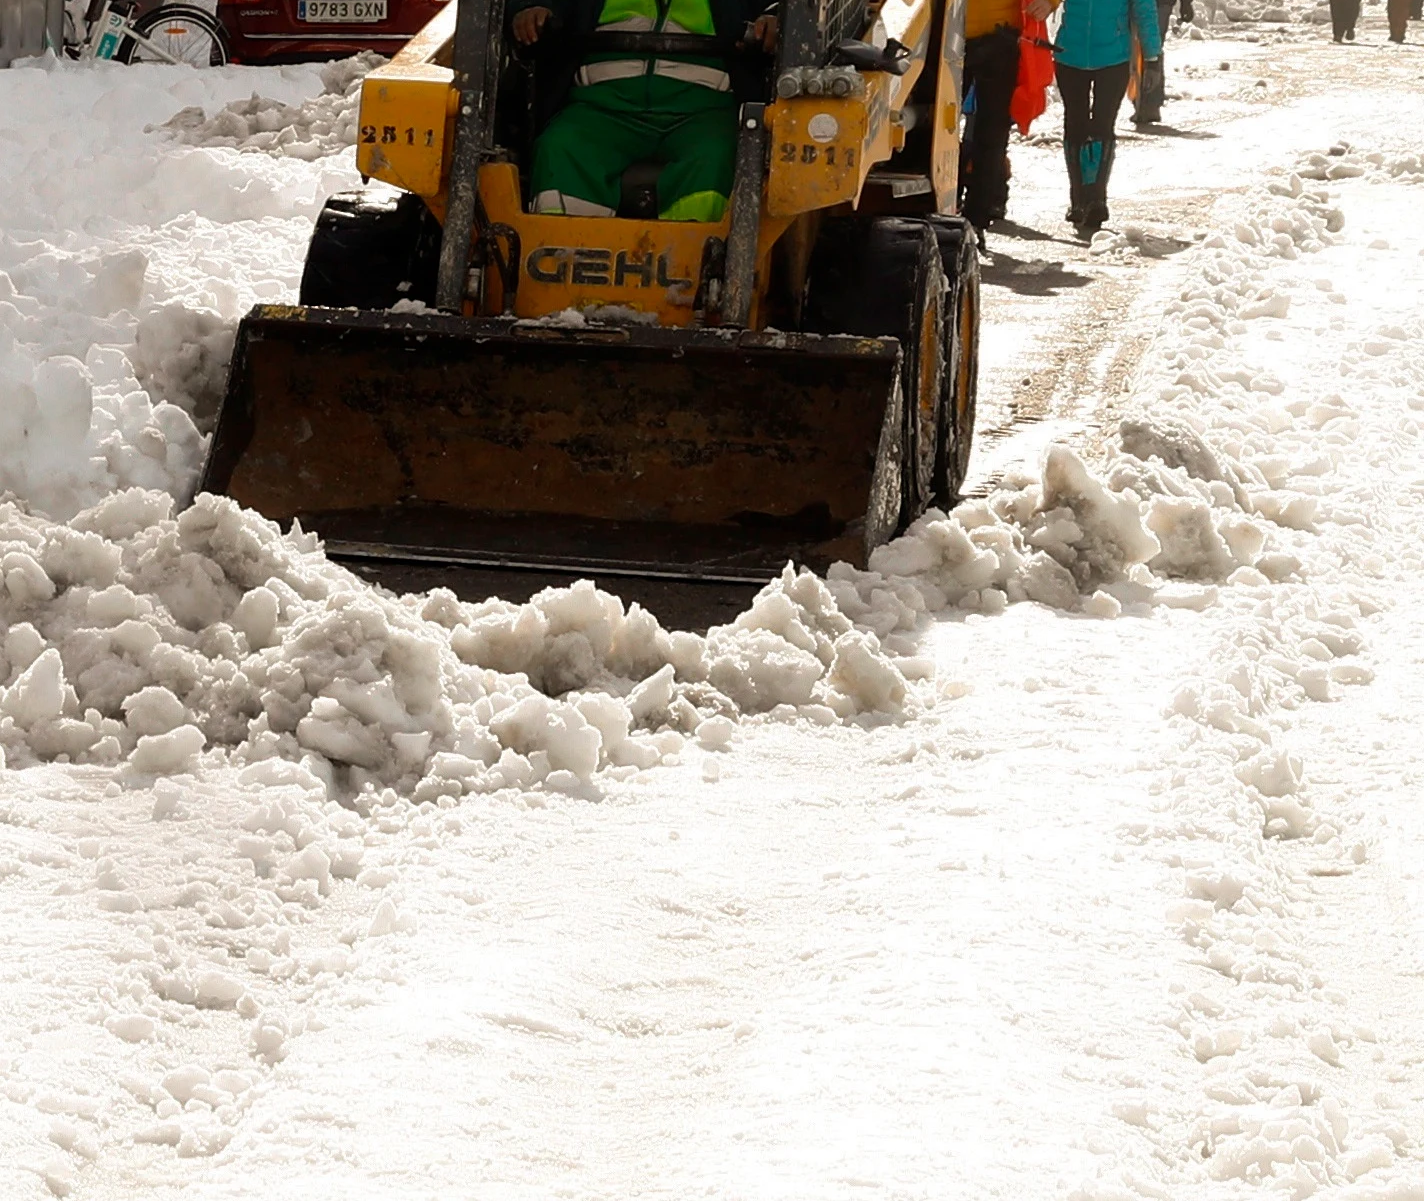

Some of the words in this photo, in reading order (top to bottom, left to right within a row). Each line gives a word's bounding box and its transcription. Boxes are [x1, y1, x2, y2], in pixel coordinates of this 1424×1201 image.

[309, 2, 348, 17] 9783
[353, 2, 384, 17] GXN
[361, 125, 435, 146] 2511
[525, 246, 693, 288] GEHL
